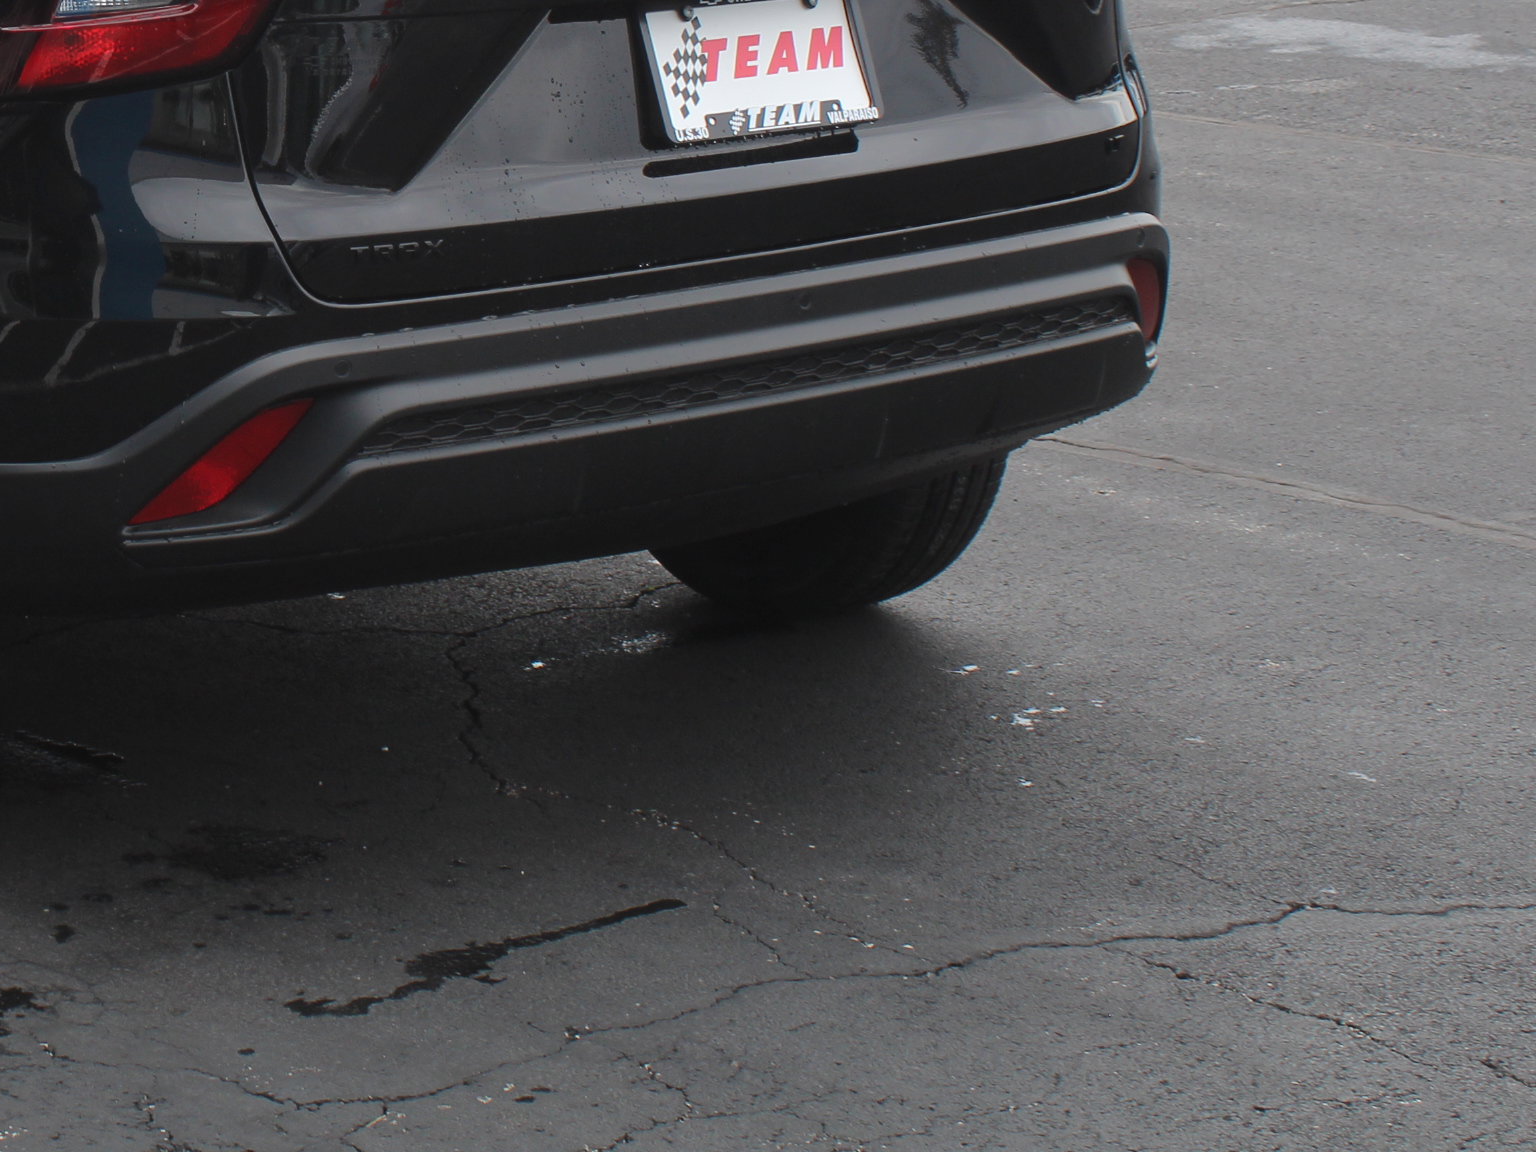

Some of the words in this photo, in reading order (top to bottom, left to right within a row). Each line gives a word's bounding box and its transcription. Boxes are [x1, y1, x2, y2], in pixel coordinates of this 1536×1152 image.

[701, 25, 844, 82] TEAM
[747, 100, 821, 129] TEAM
[826, 106, 880, 123] VALPARAISO
